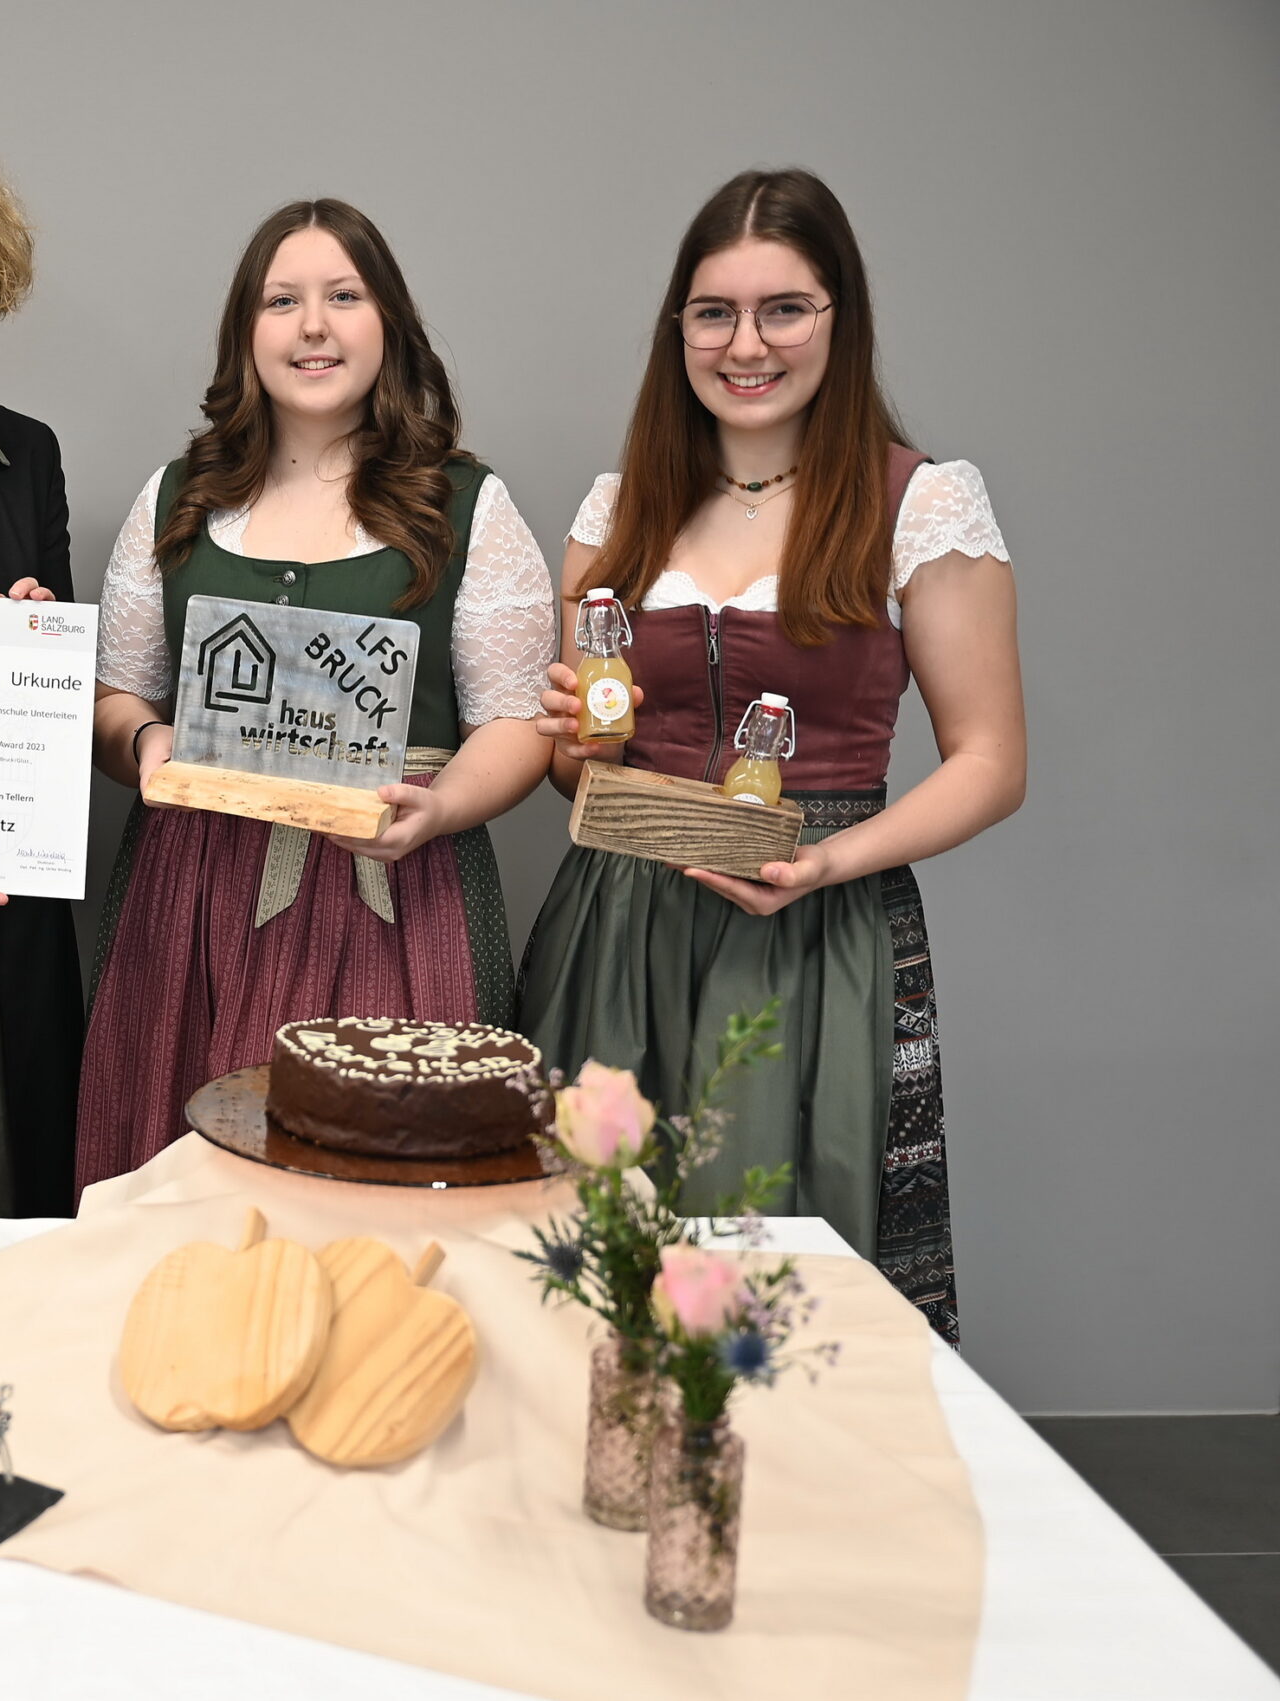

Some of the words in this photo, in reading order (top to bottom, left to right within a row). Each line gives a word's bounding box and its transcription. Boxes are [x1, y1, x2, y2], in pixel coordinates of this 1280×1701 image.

[42, 616, 64, 624] LAND
[41, 624, 85, 634] SALZBURG
[355, 622, 408, 675] LFS
[11, 672, 82, 691] Urkunde
[304, 633, 397, 729] BRUCK
[30, 710, 77, 720] Unterleiten
[280, 699, 336, 731] haus
[26, 742, 45, 751] 2023
[240, 722, 390, 768] wirtschaft
[6, 793, 34, 802] Tellern
